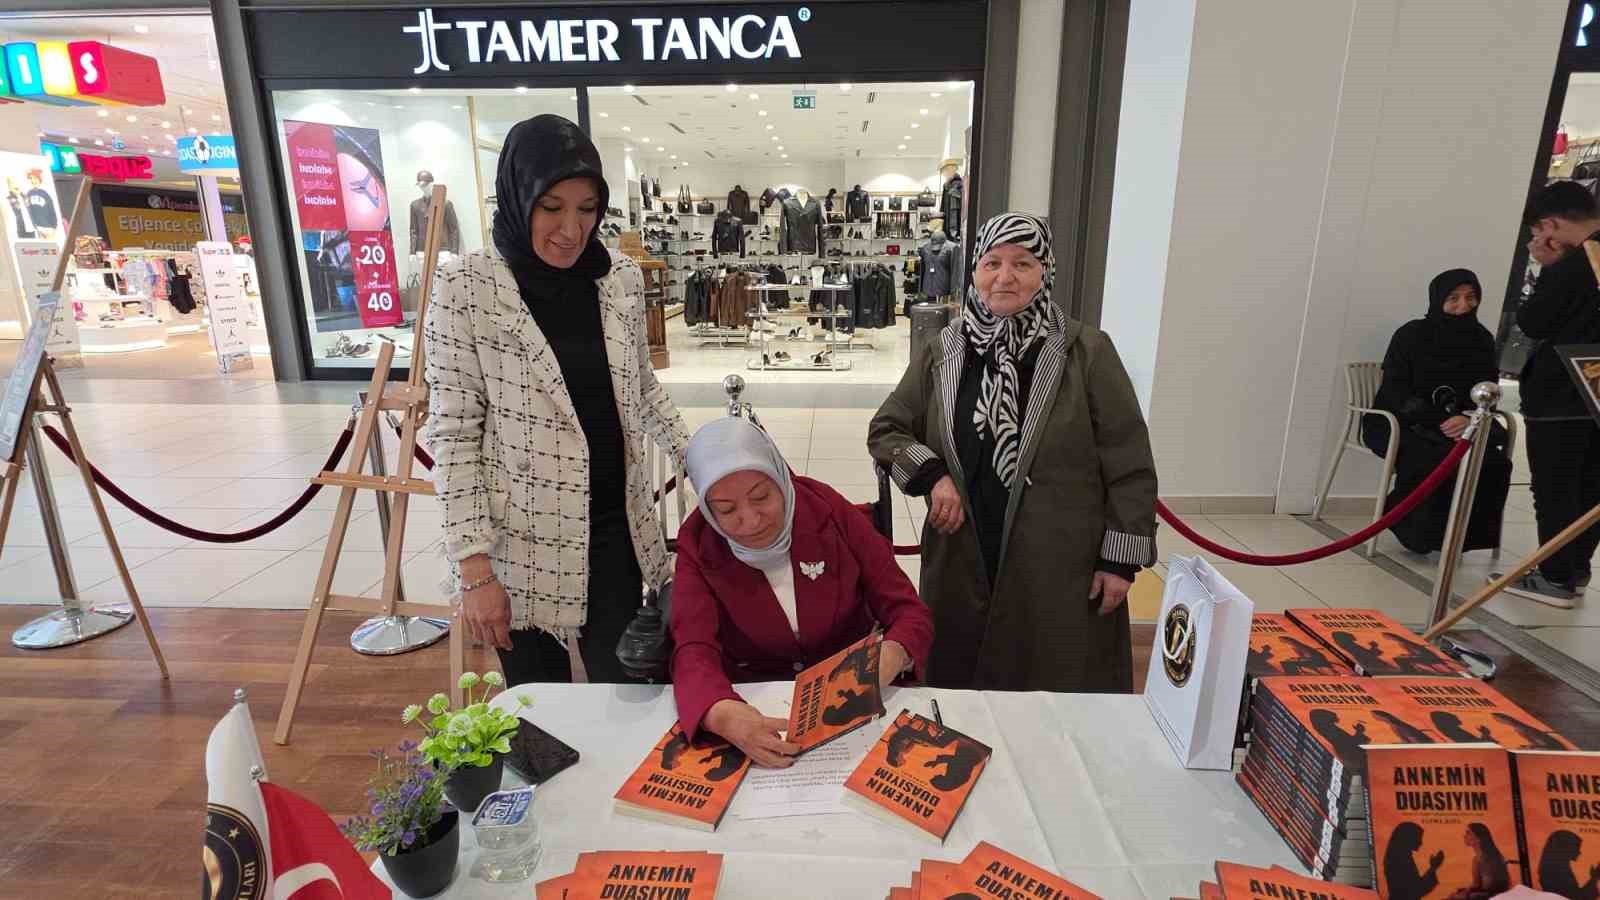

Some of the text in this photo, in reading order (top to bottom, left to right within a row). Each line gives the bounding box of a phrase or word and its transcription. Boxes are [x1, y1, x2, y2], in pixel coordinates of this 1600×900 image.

[455, 18, 620, 63] TAMER
[631, 14, 801, 60] TANCA
[360, 245, 385, 265] 20
[367, 292, 393, 311] 40
[1288, 683, 1368, 693] ANNEMİN
[1400, 685, 1481, 696] ANNEMİN
[1298, 694, 1379, 705] DUASIYIM
[1412, 696, 1497, 707] DUASIYIM
[1393, 763, 1487, 786] ANNEMİN
[1546, 772, 1600, 794] ANNE
[647, 773, 714, 798] DUASIYIM
[874, 767, 941, 808] DUASIYIM
[639, 782, 708, 810] ANNEMİN
[865, 777, 935, 819] ANNEMİN
[1395, 791, 1489, 811] DUASIYIM
[1548, 798, 1600, 820] DUAS
[607, 863, 697, 883] ANNEMİN
[599, 883, 692, 900] DUASIYIM
